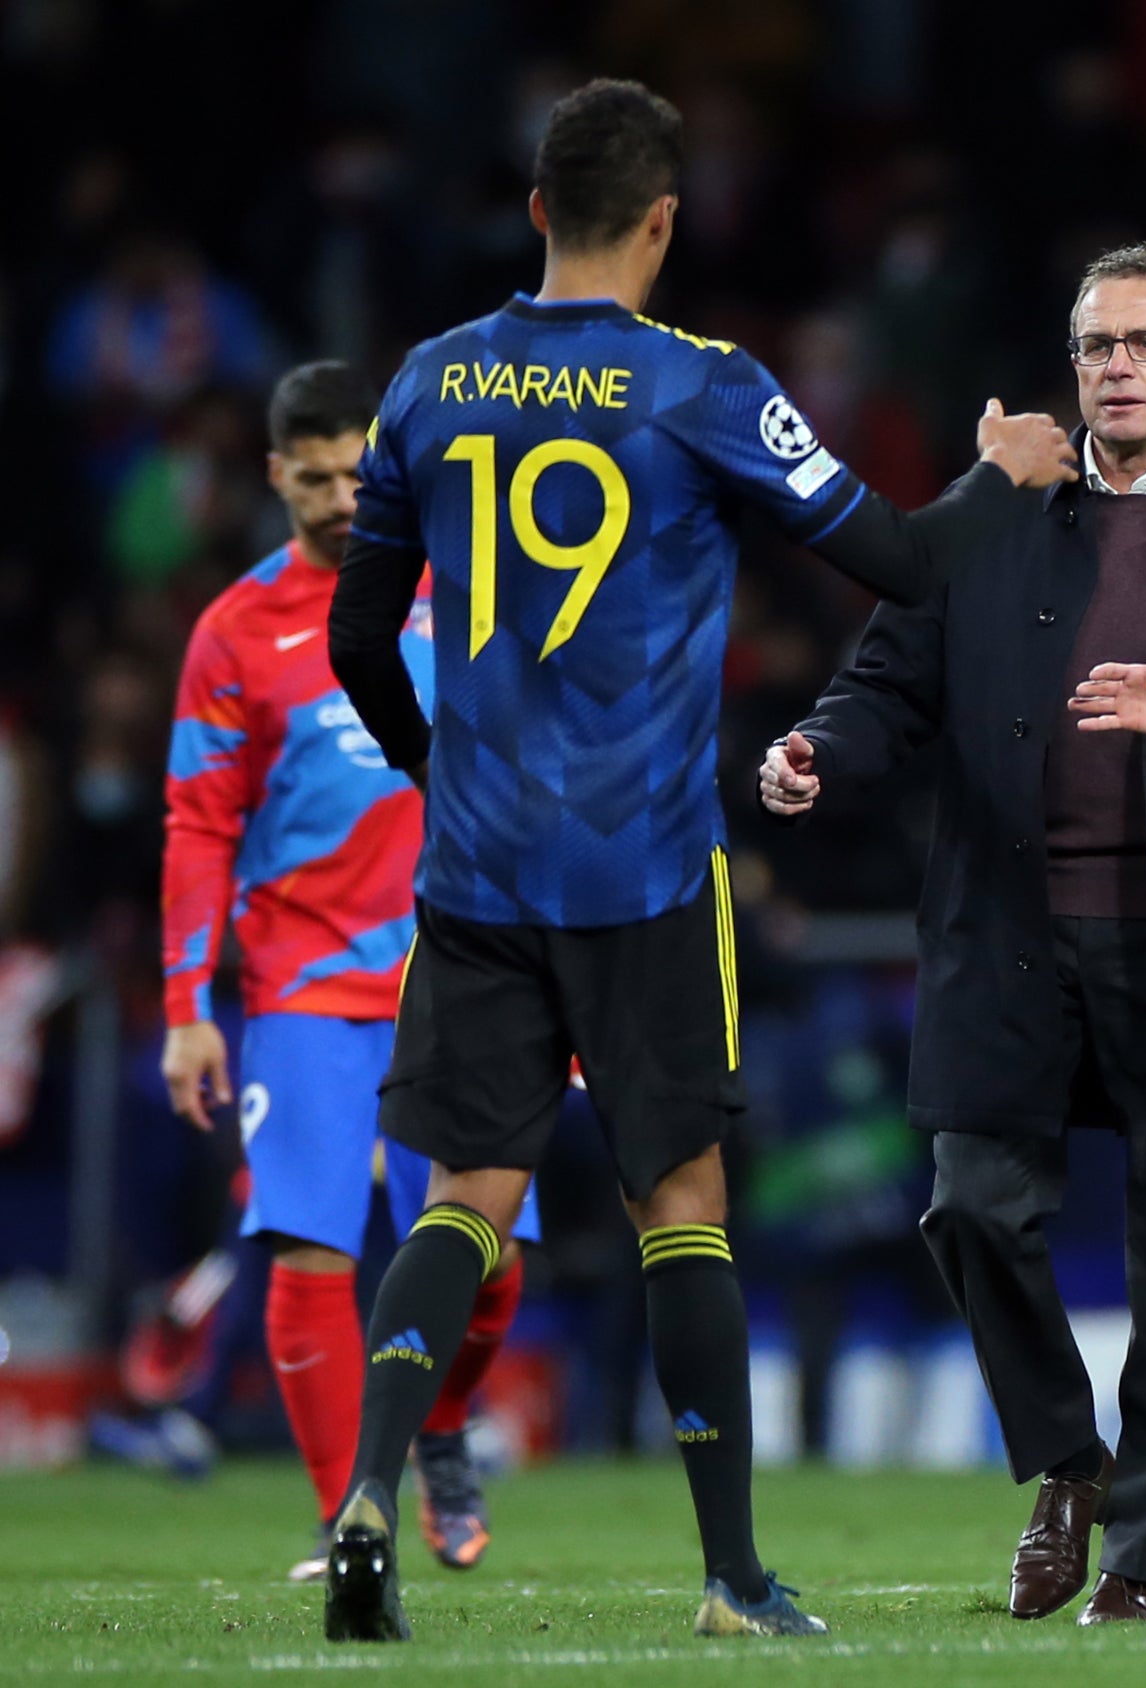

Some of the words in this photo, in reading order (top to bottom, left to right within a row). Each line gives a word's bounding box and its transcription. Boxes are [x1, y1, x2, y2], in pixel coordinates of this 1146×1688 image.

[440, 361, 633, 413] R.VARANE
[442, 434, 631, 663] 19
[371, 1344, 434, 1371] adidas
